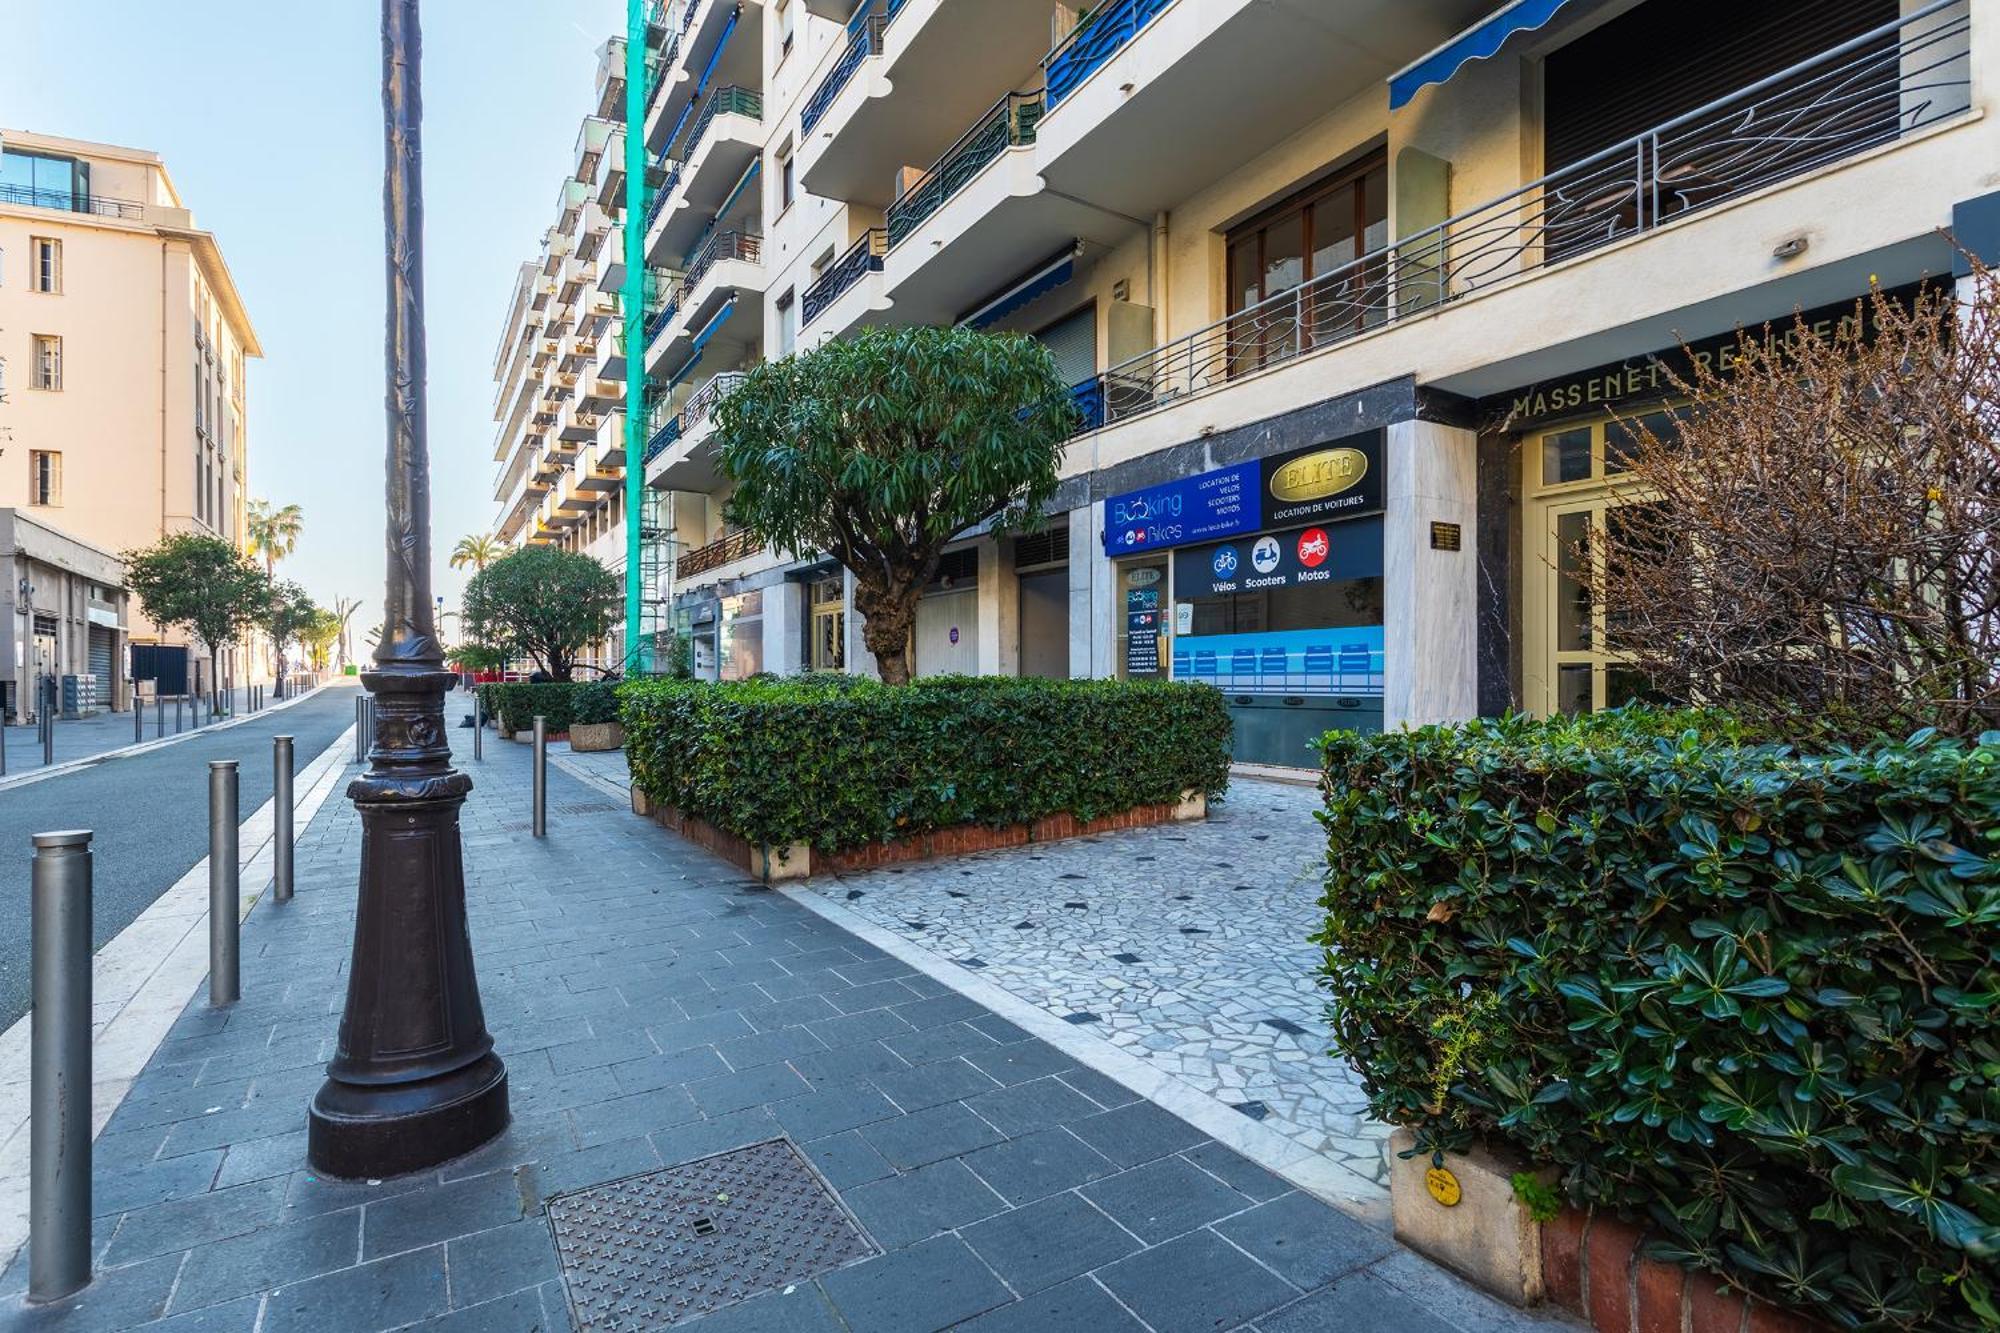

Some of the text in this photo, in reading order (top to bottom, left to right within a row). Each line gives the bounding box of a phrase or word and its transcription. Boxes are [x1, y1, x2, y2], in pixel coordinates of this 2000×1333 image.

[1513, 365, 1661, 418] MASSENET
[1283, 455, 1354, 489] ELITE
[1199, 473, 1240, 490] LOCATION DE
[1208, 495, 1241, 507] SCOOTERS
[1274, 495, 1364, 520] LOCATION DE VOITURES
[1115, 494, 1182, 524] Booking
[1216, 504, 1241, 515] MOTOS
[1245, 575, 1287, 589] Scooters
[1297, 569, 1331, 583] Motos
[1212, 581, 1237, 593] Vélos
